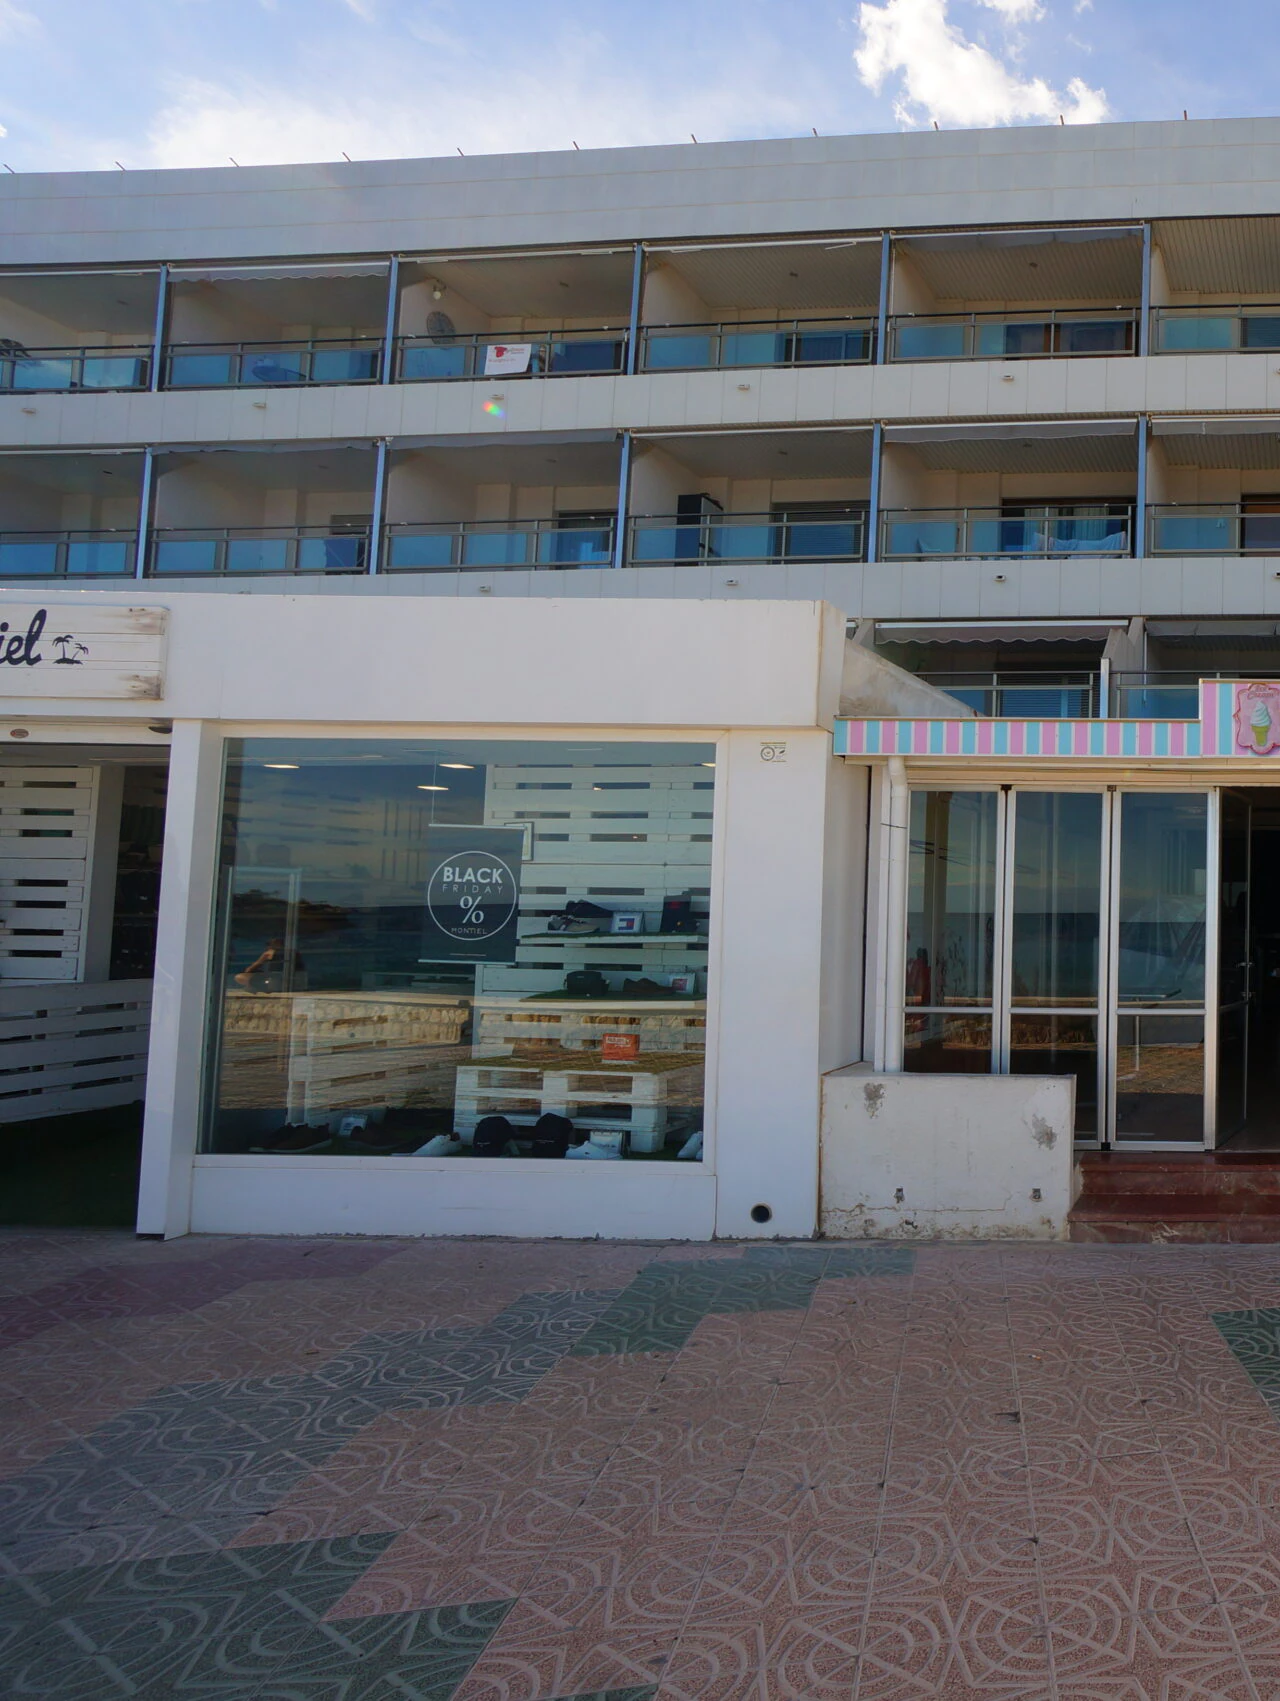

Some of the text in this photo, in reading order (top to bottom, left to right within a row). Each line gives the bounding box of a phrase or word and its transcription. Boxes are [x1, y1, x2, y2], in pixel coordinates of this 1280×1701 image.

[443, 867, 503, 884] BLACK
[442, 884, 503, 894] FRIDAY
[460, 896, 484, 924] %
